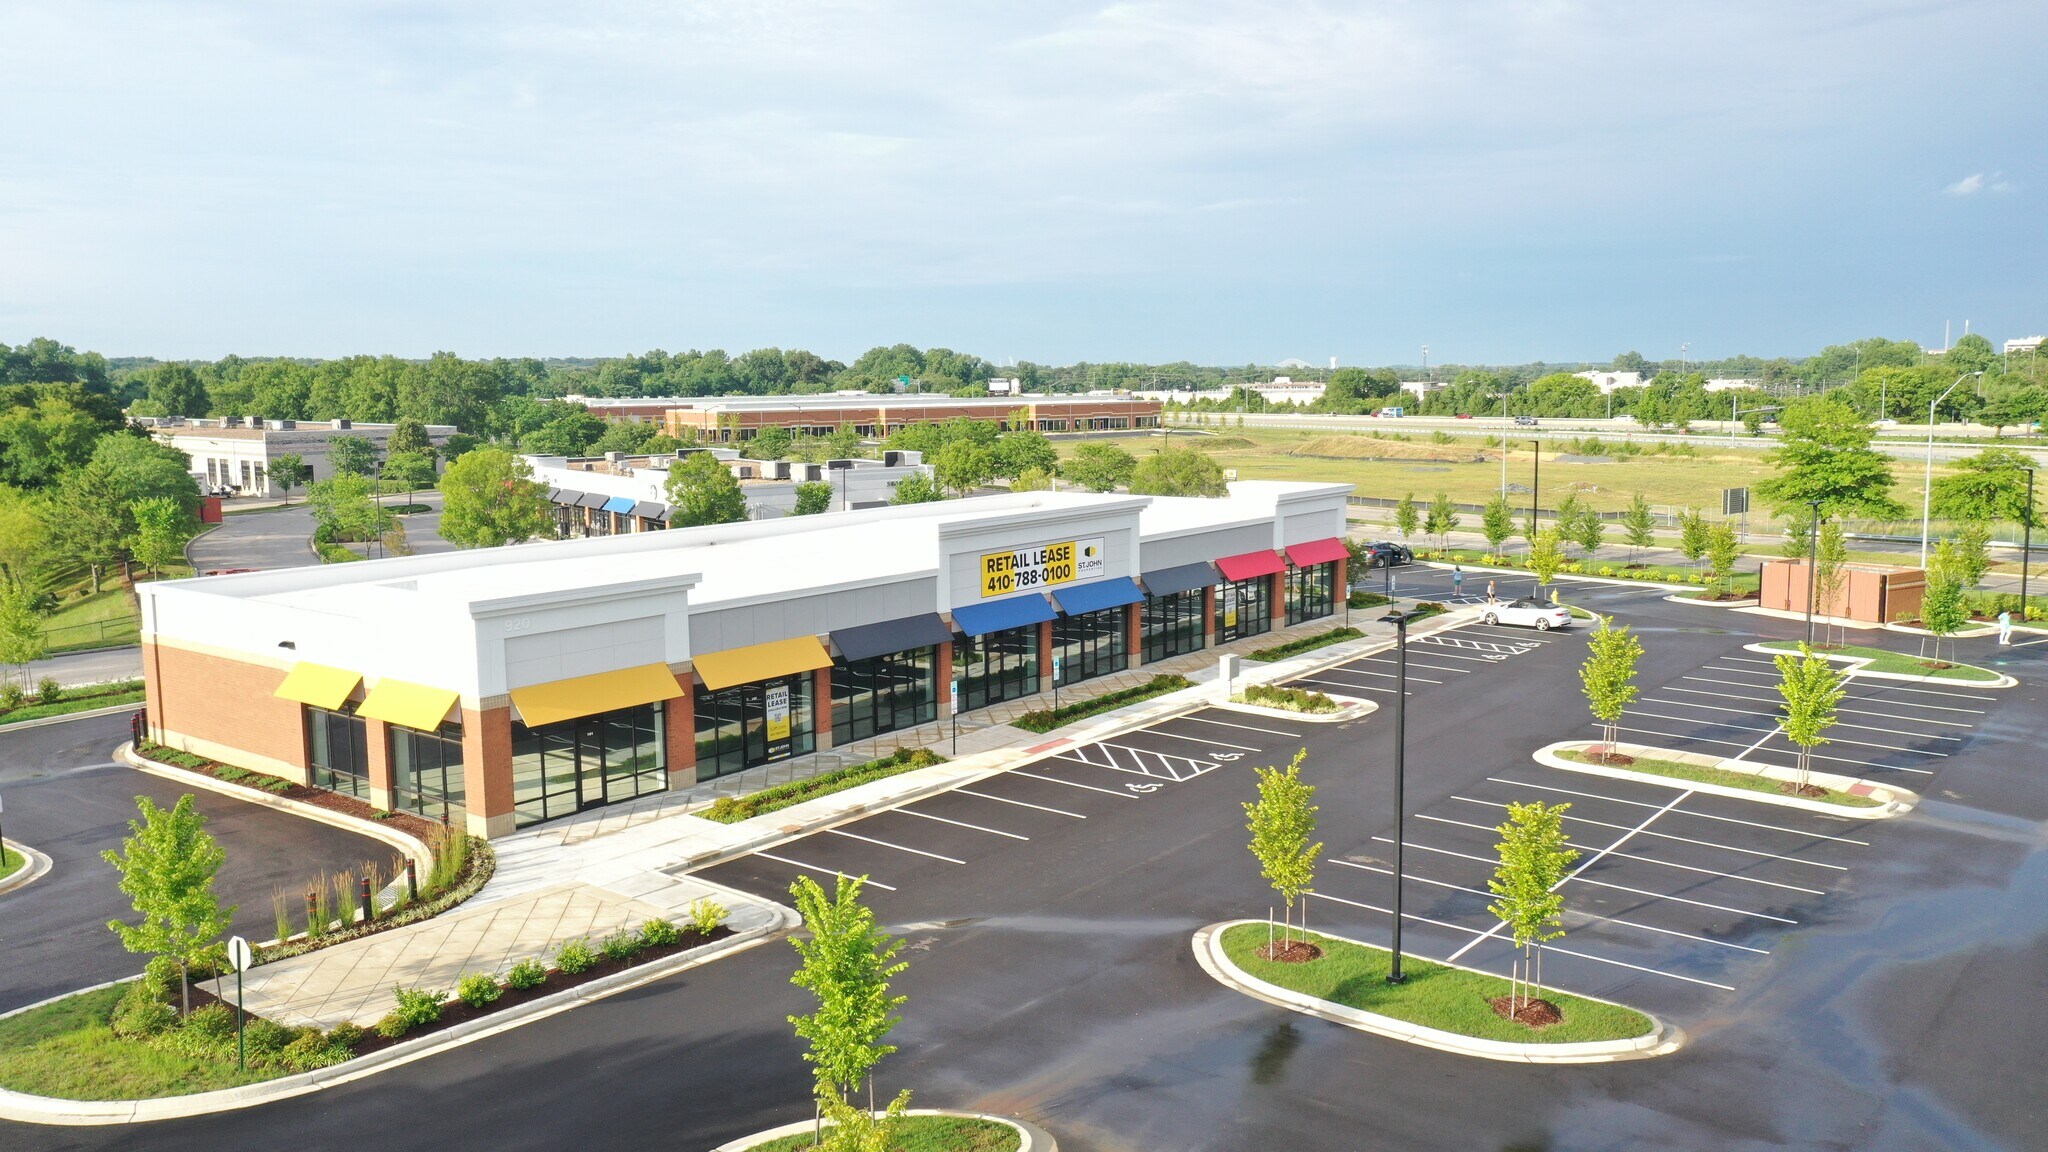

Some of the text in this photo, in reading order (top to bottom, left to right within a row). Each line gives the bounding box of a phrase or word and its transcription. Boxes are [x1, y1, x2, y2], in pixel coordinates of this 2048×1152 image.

[987, 546, 1070, 574] RETAIL LEASE
[988, 564, 1071, 591] 410-788-0100
[505, 618, 530, 632] 920
[767, 691, 787, 700] RETAIL
[767, 699, 787, 707] LEASE
